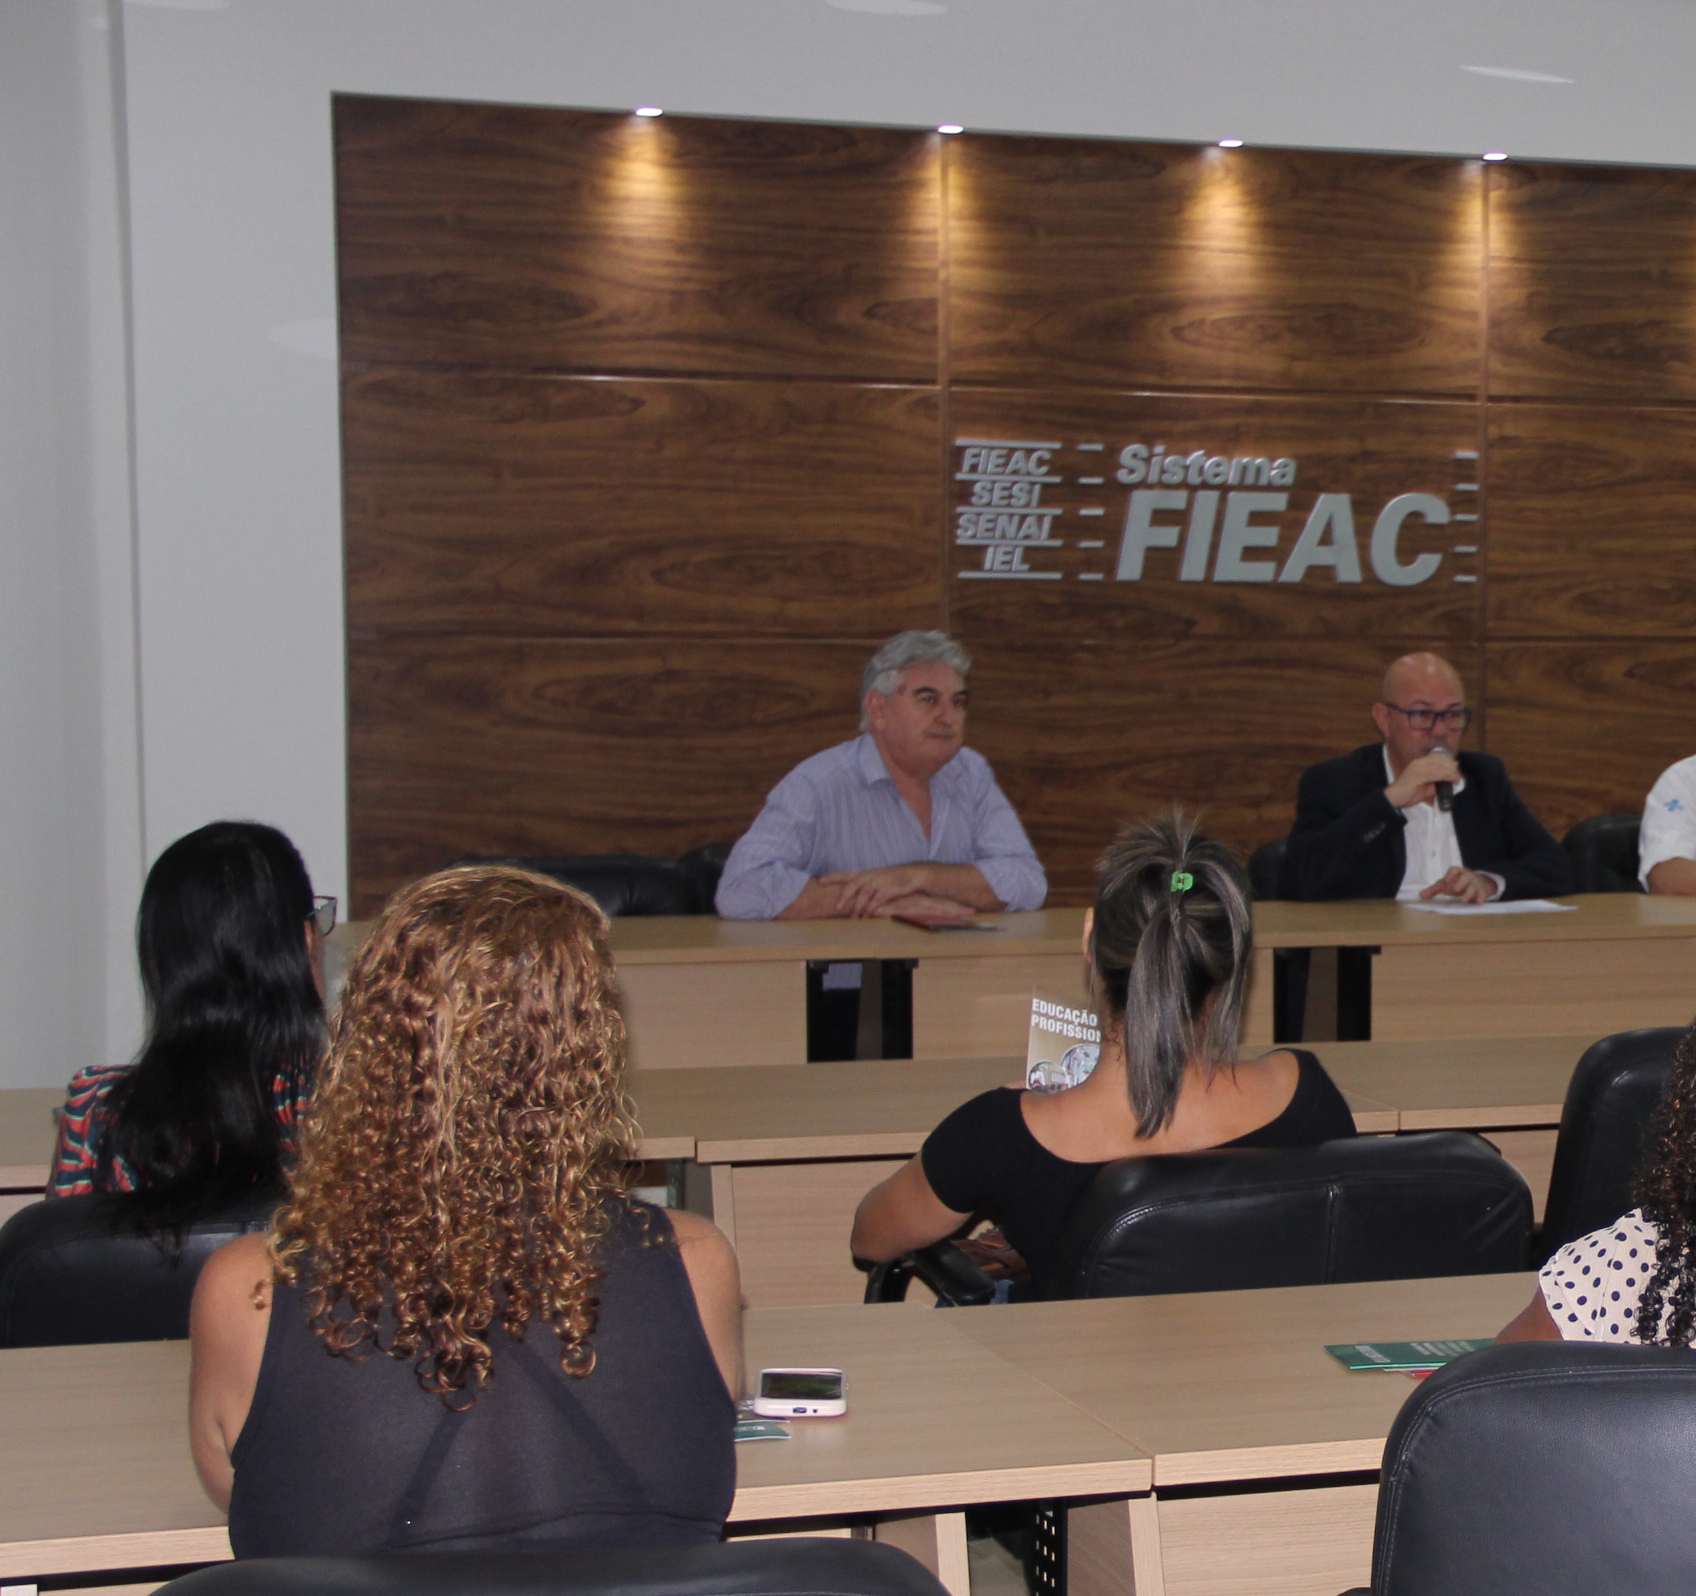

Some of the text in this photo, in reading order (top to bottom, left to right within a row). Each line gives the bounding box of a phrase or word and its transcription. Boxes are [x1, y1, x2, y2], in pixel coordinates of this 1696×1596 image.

[962, 447, 1052, 476] FIEAC
[1116, 443, 1298, 486] Sistema
[971, 480, 1041, 508] SESI
[956, 514, 1053, 540] SENAI
[1115, 490, 1451, 586] FIEAC
[983, 546, 1031, 571] IEL
[1032, 998, 1098, 1027] EDUCAÇÃO
